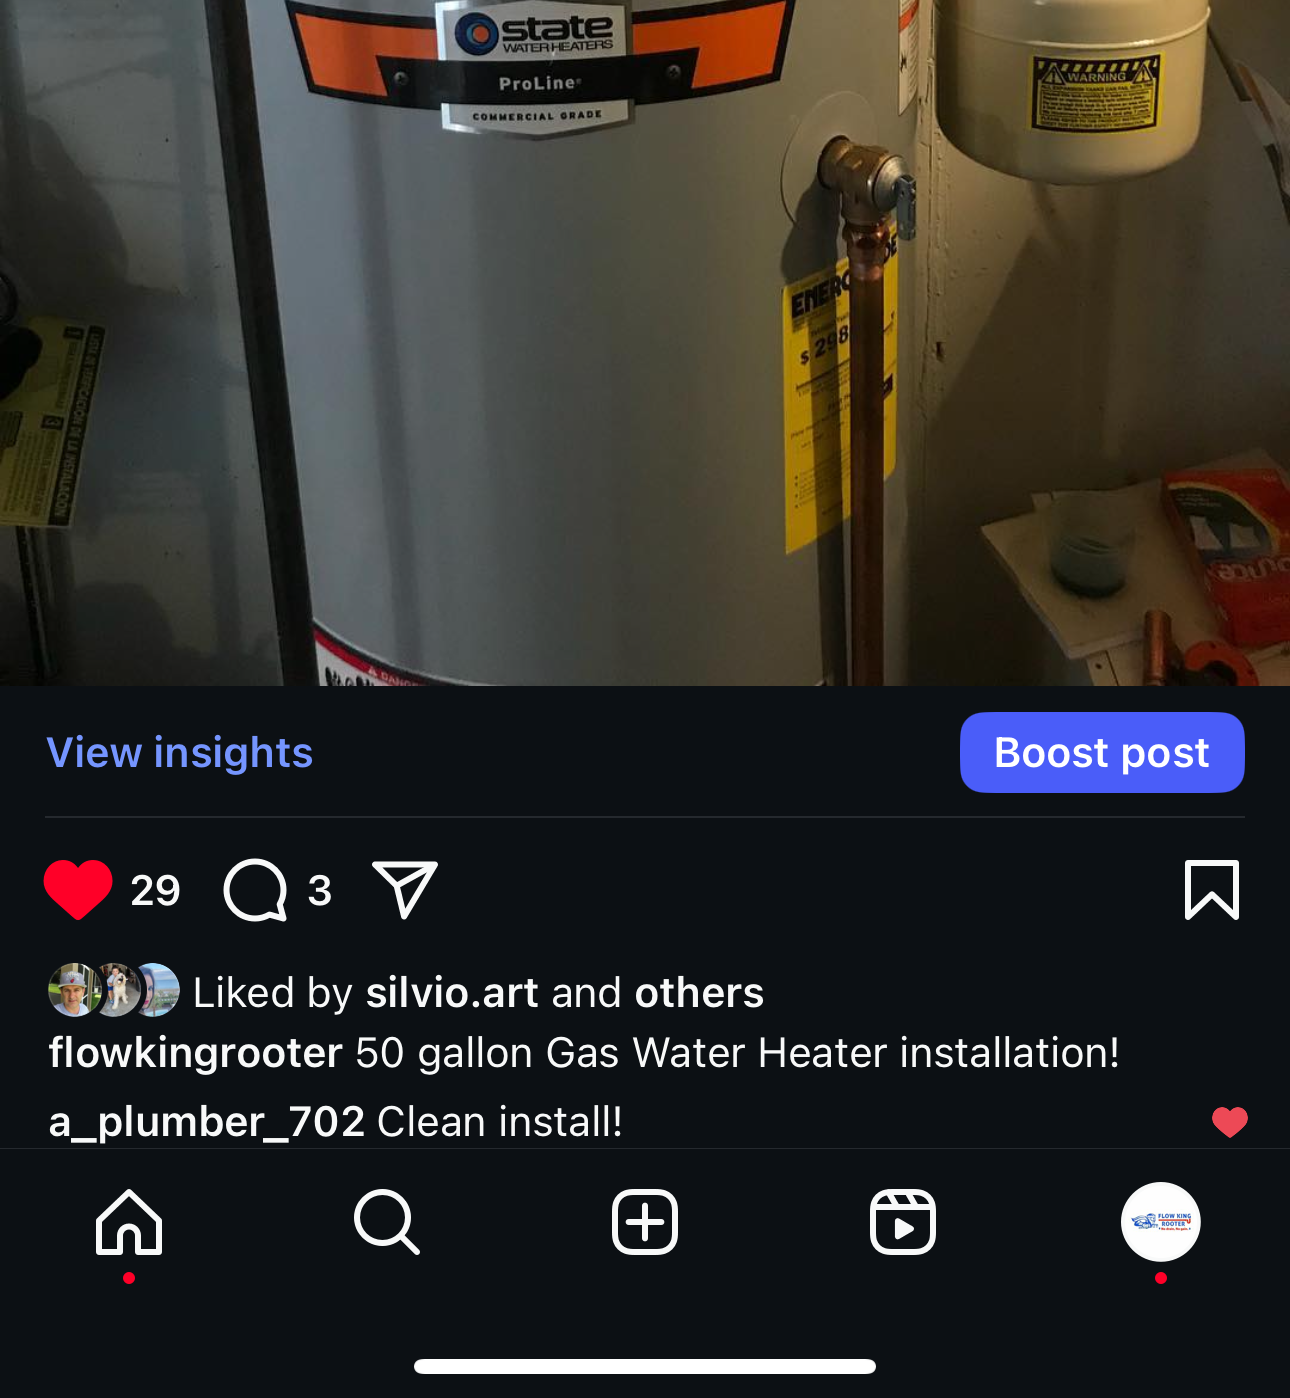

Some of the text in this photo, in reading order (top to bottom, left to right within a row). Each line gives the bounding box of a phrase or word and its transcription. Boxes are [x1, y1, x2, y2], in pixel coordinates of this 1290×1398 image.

[502, 15, 614, 42] state
[503, 39, 614, 53] WATER HEATERS
[1067, 72, 1127, 82] WARNING
[472, 110, 602, 121] COMMERCIAL GRADE
[45, 734, 313, 776] View insights
[995, 736, 1210, 776] Boost post
[131, 873, 181, 907] 29
[307, 874, 332, 907] 3
[194, 974, 764, 1016] Liked by silvio.art and others
[48, 1034, 1119, 1076] flowkingrooter 50 gallon Gas Water Heater installation!
[49, 1104, 622, 1145] a_plumber_702 Clean install!
